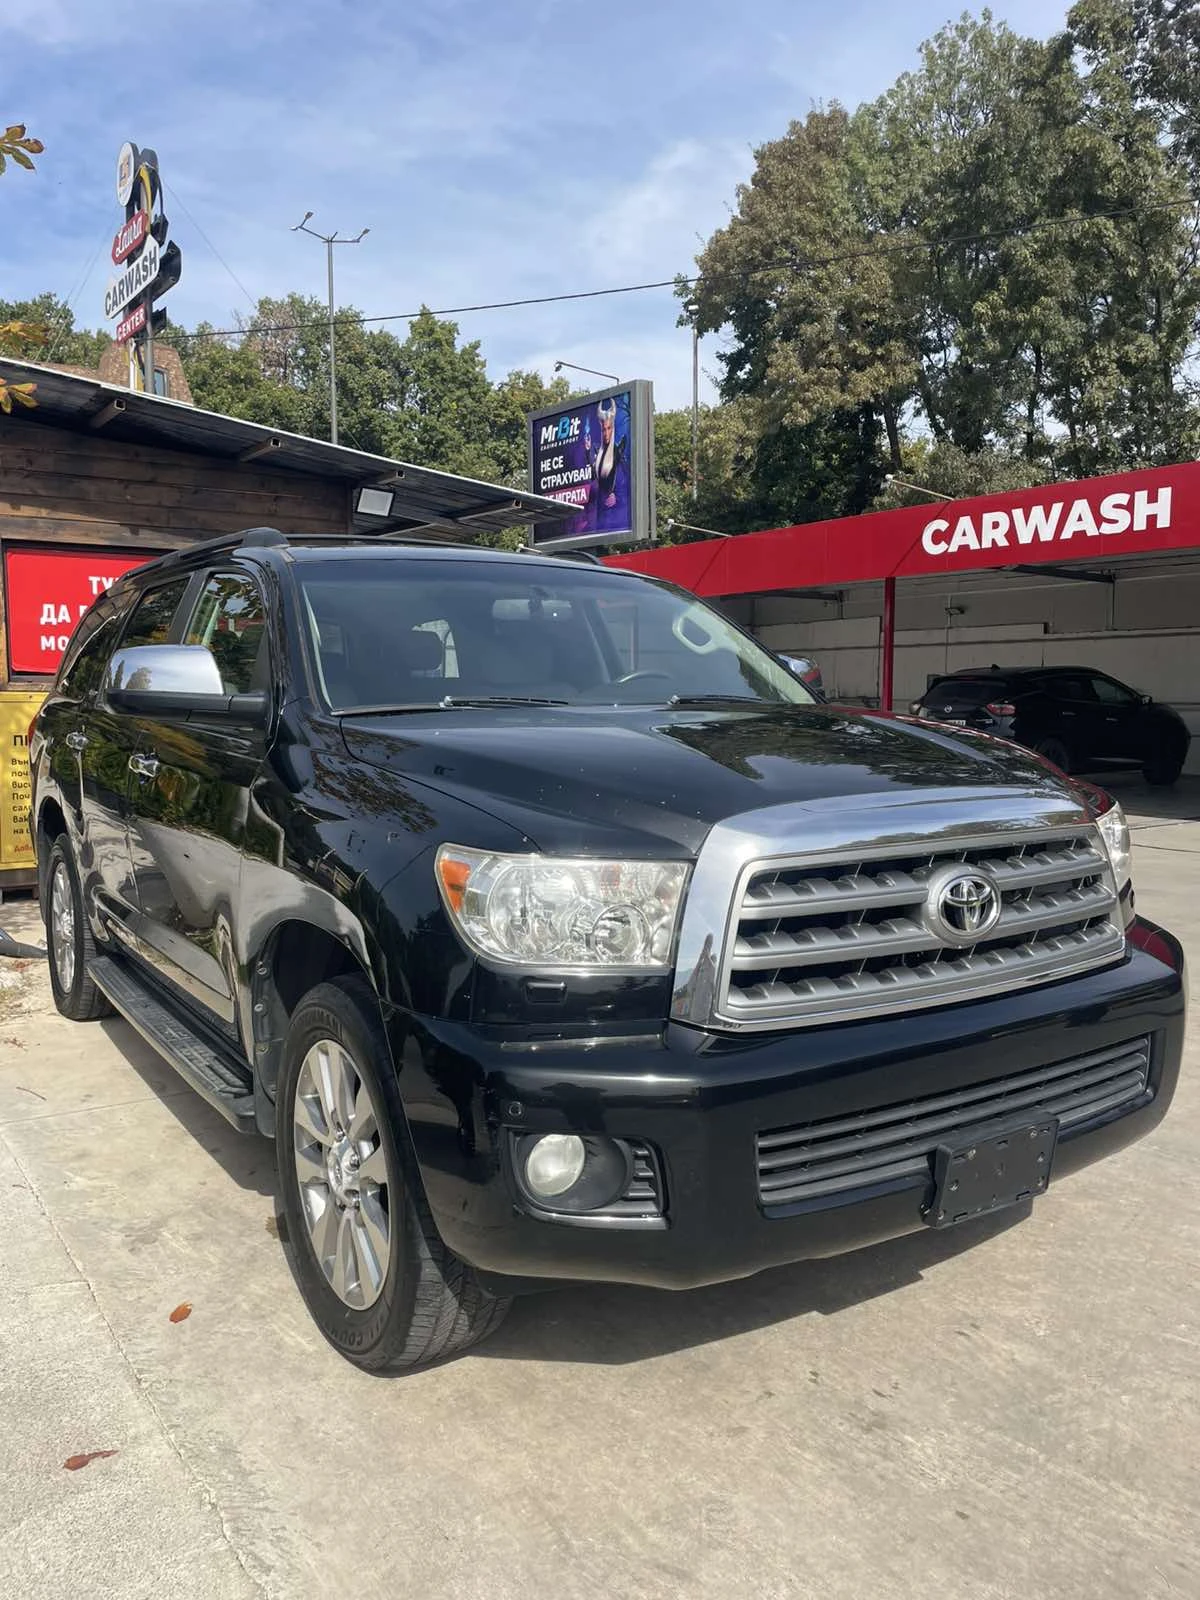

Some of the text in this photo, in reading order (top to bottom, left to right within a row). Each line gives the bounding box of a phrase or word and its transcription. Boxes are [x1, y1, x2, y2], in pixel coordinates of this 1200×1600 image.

[105, 246, 157, 316] CARWASH
[118, 307, 145, 341] CENTER
[541, 416, 581, 444] MrBit
[540, 456, 564, 472] НЕ СЕ
[540, 464, 592, 489] СТРАХУВАЙ
[922, 486, 1173, 555] CARWASH
[40, 603, 71, 625] ДА
